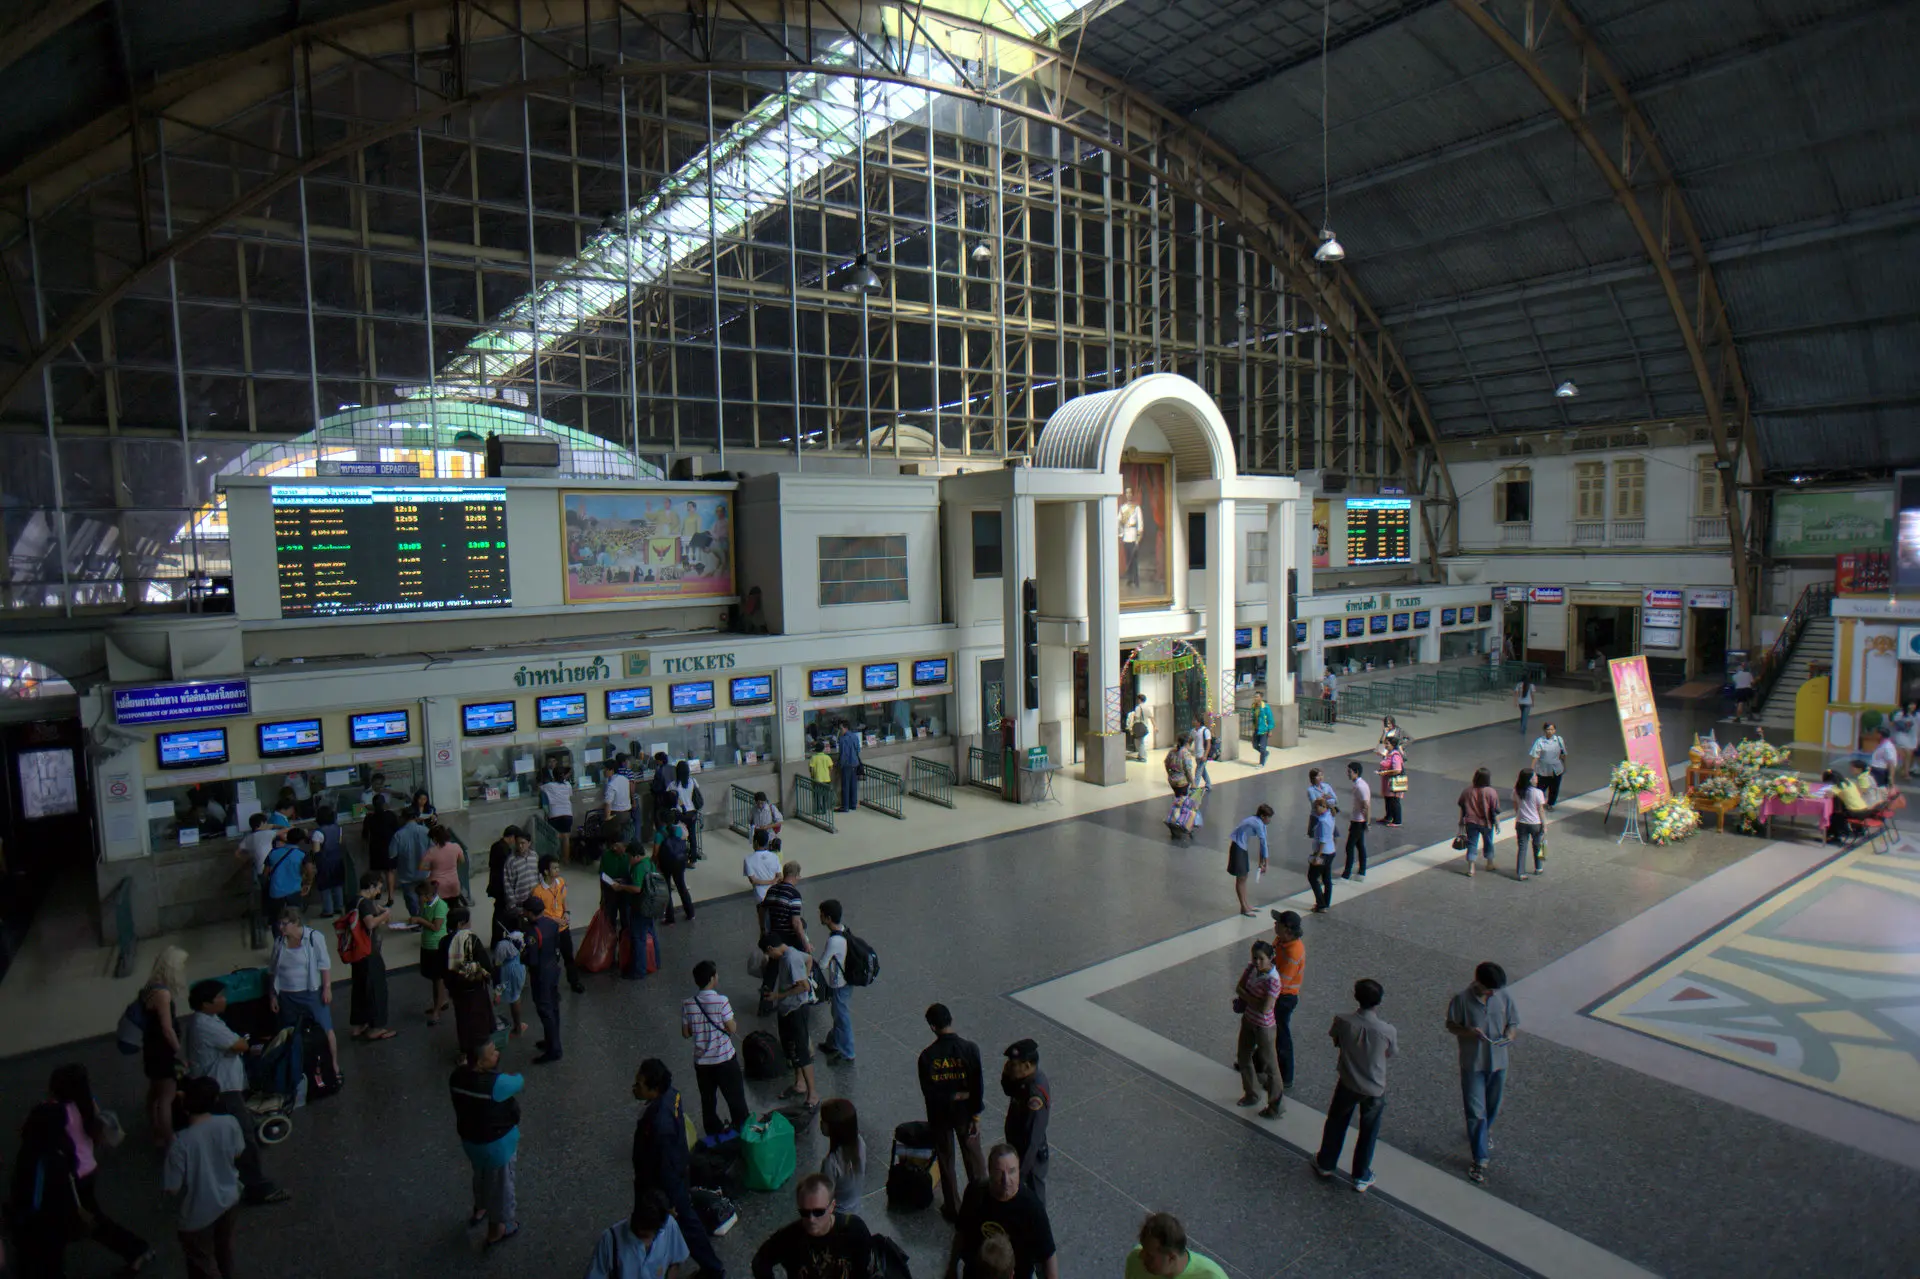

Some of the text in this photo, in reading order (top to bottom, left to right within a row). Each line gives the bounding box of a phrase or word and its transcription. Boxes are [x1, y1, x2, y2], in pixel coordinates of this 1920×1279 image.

[380, 464, 419, 474] DEPARTURE
[1396, 597, 1421, 607] TICKETS
[663, 653, 736, 674] TICKETS
[514, 655, 610, 687] จำหน่ายตั๋ว
[118, 710, 160, 720] POSTPONEMENT
[931, 1072, 966, 1081] SECURITY
